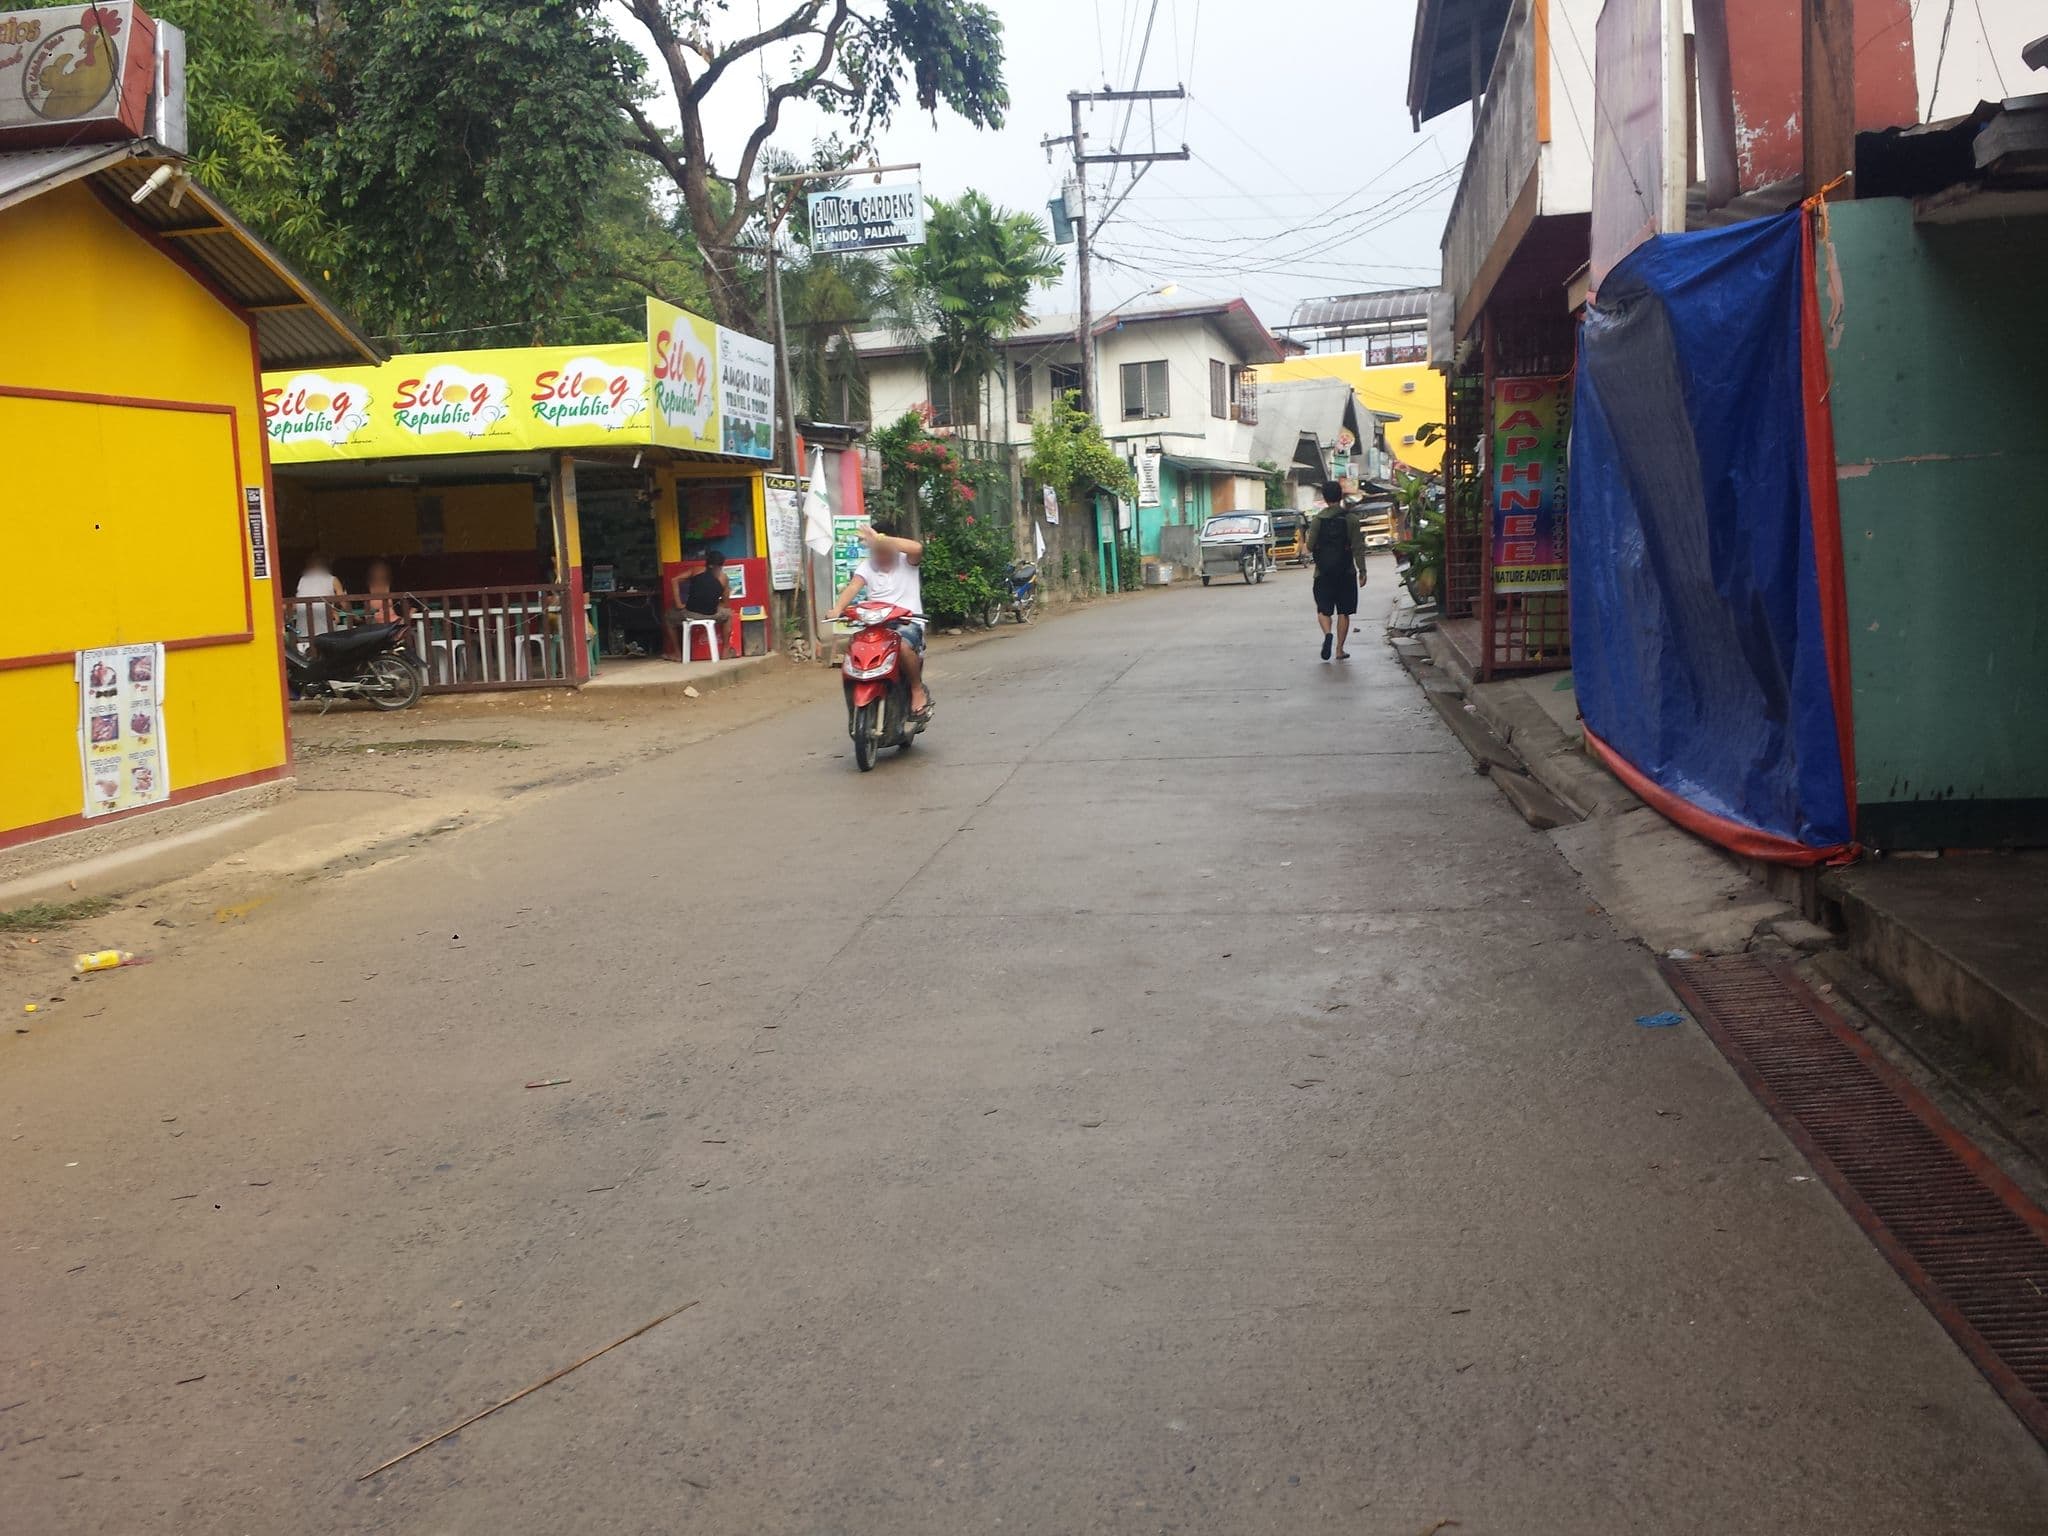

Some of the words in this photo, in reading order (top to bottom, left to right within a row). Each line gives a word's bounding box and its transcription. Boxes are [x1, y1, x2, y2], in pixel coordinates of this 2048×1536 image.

[859, 192, 915, 222] GARDENS
[816, 231, 827, 244] EL
[865, 223, 916, 240] PALAWAN
[392, 379, 490, 415] Silog
[531, 370, 630, 408] Silog
[655, 380, 697, 427] Republic
[393, 403, 470, 434] Republic
[531, 396, 609, 427] Republic
[1499, 381, 1544, 563] DAPHNEE
[1495, 570, 1525, 583] NATURE
